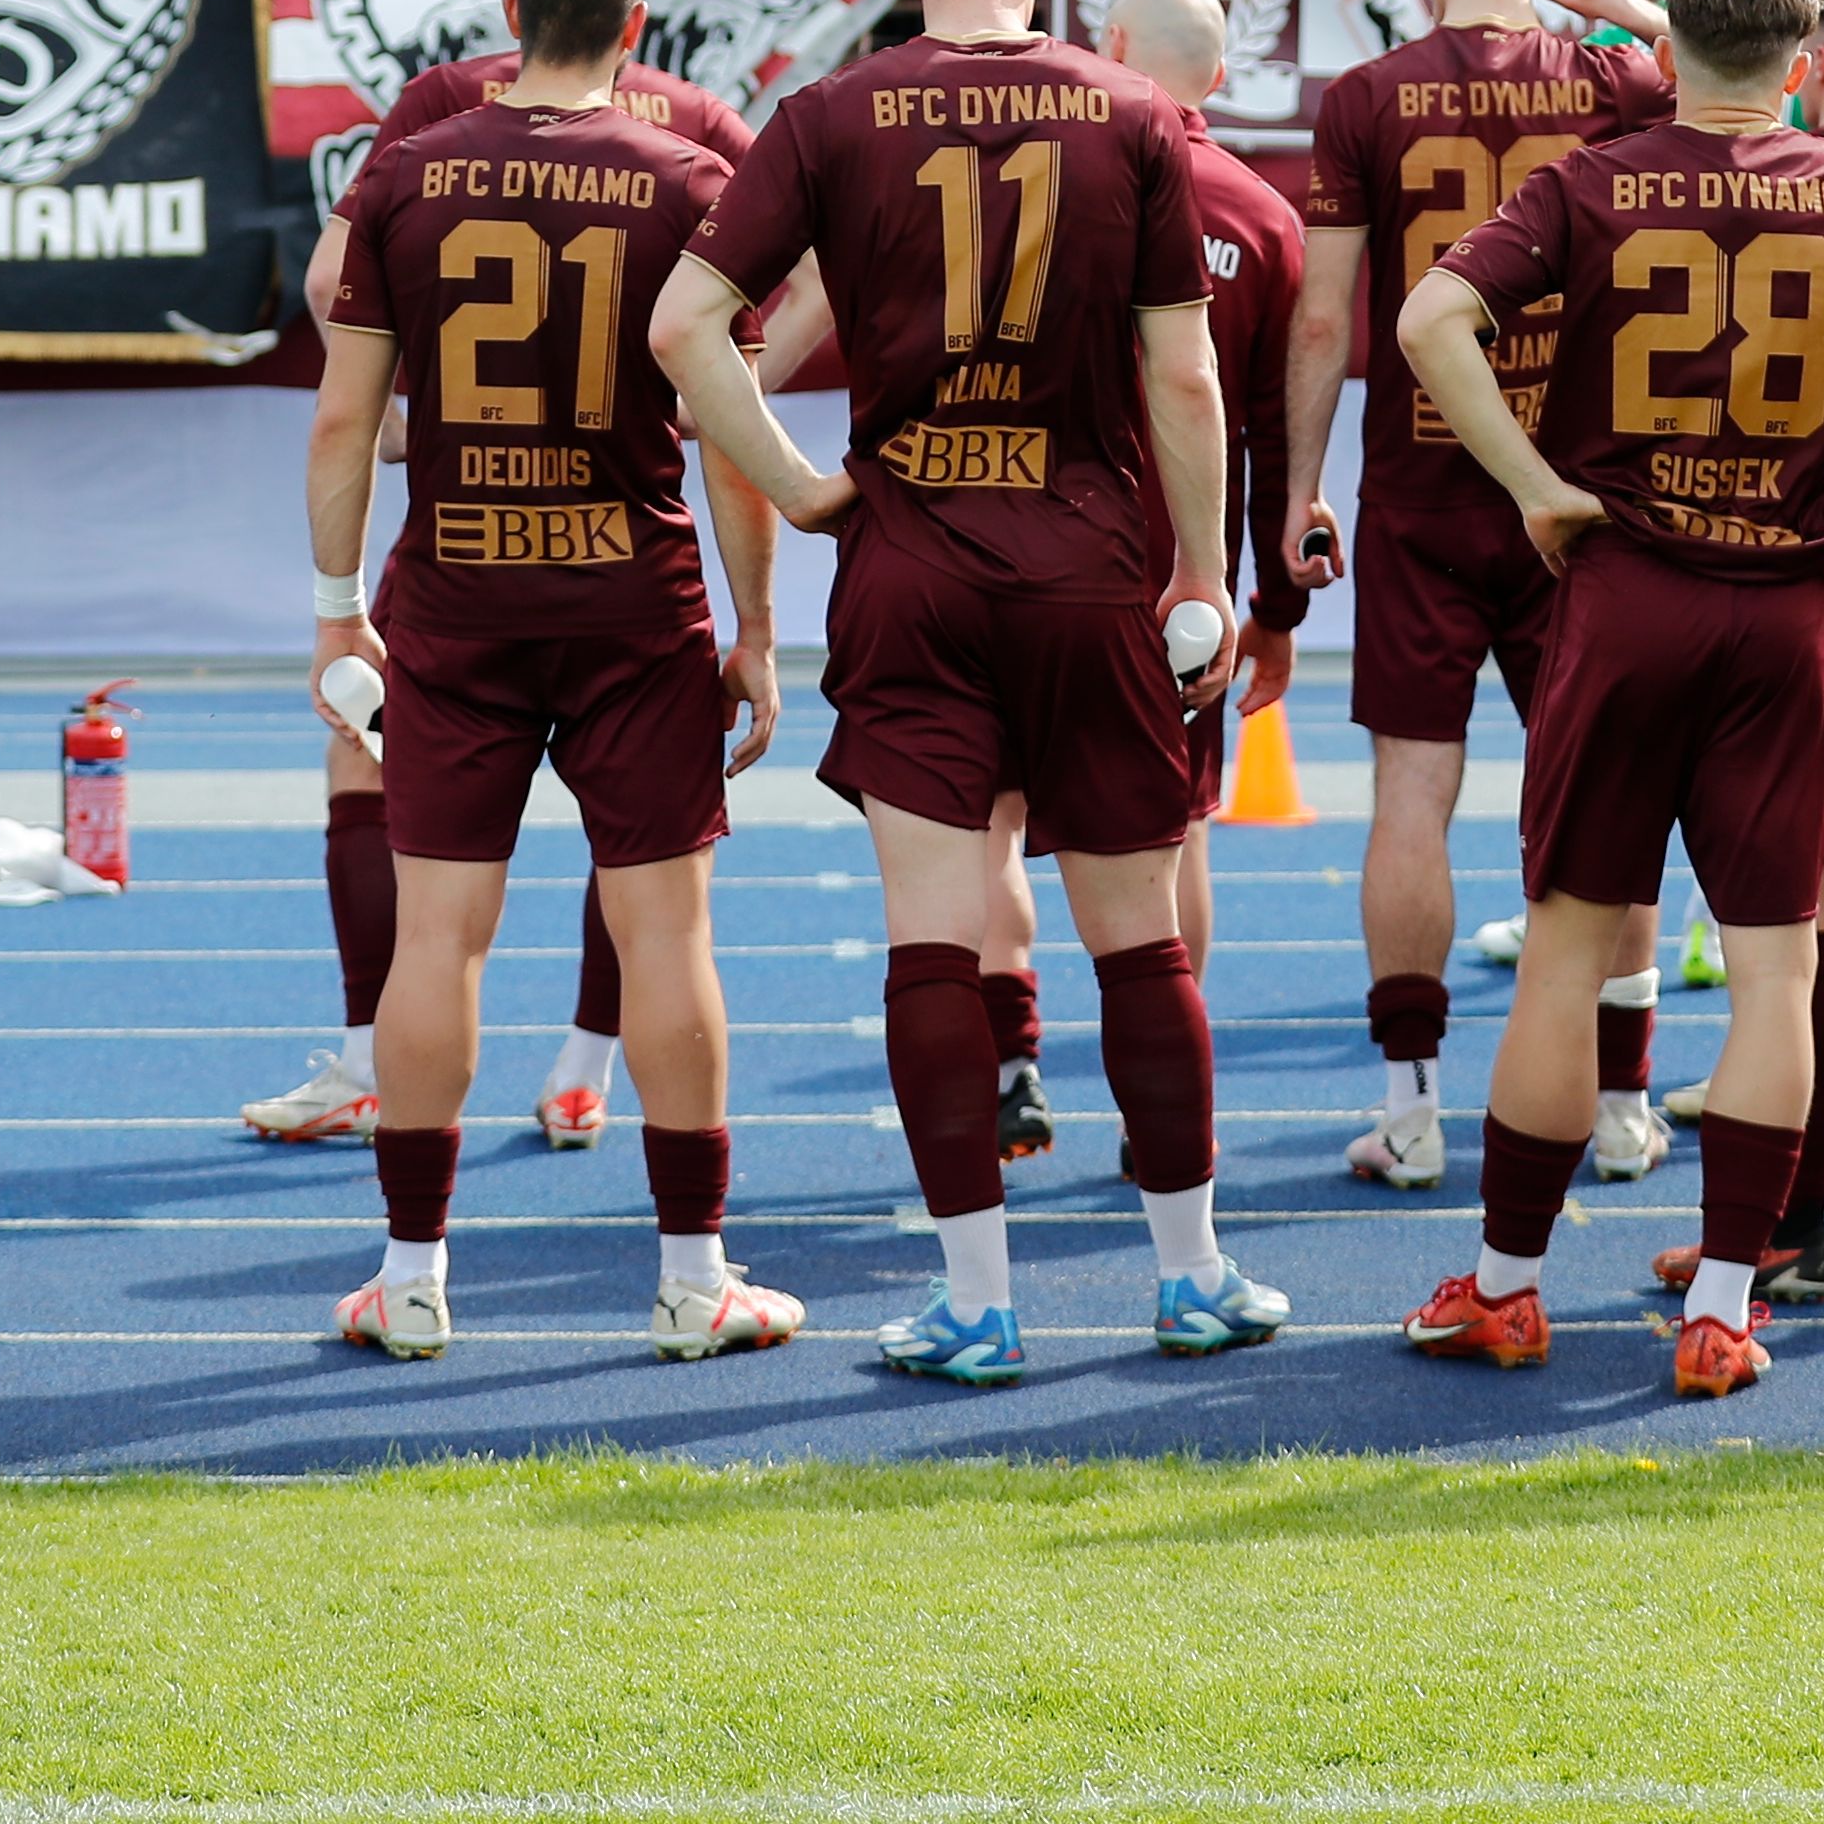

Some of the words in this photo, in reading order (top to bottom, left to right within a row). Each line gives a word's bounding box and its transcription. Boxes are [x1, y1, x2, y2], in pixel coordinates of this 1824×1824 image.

[872, 89, 947, 127] BFC
[959, 86, 1111, 125] DYNAMO
[1398, 83, 1461, 117] BFC
[1470, 80, 1594, 115] DYNAMO
[422, 158, 490, 199] BFC
[502, 161, 655, 209] DYNAMO
[1614, 173, 1687, 210] BFC
[916, 140, 1061, 354] 11
[440, 219, 628, 431] 21
[948, 335, 972, 349] BFC
[1001, 323, 1026, 339] BFC
[481, 407, 503, 421] BFC
[578, 411, 601, 426] BFC
[1654, 417, 1678, 431] BFC
[1765, 420, 1789, 434] BFC
[461, 445, 592, 487] DEDIDIS
[921, 428, 1043, 487] BBK
[1650, 452, 1784, 500] SUSSEK
[492, 506, 632, 562] BBK
